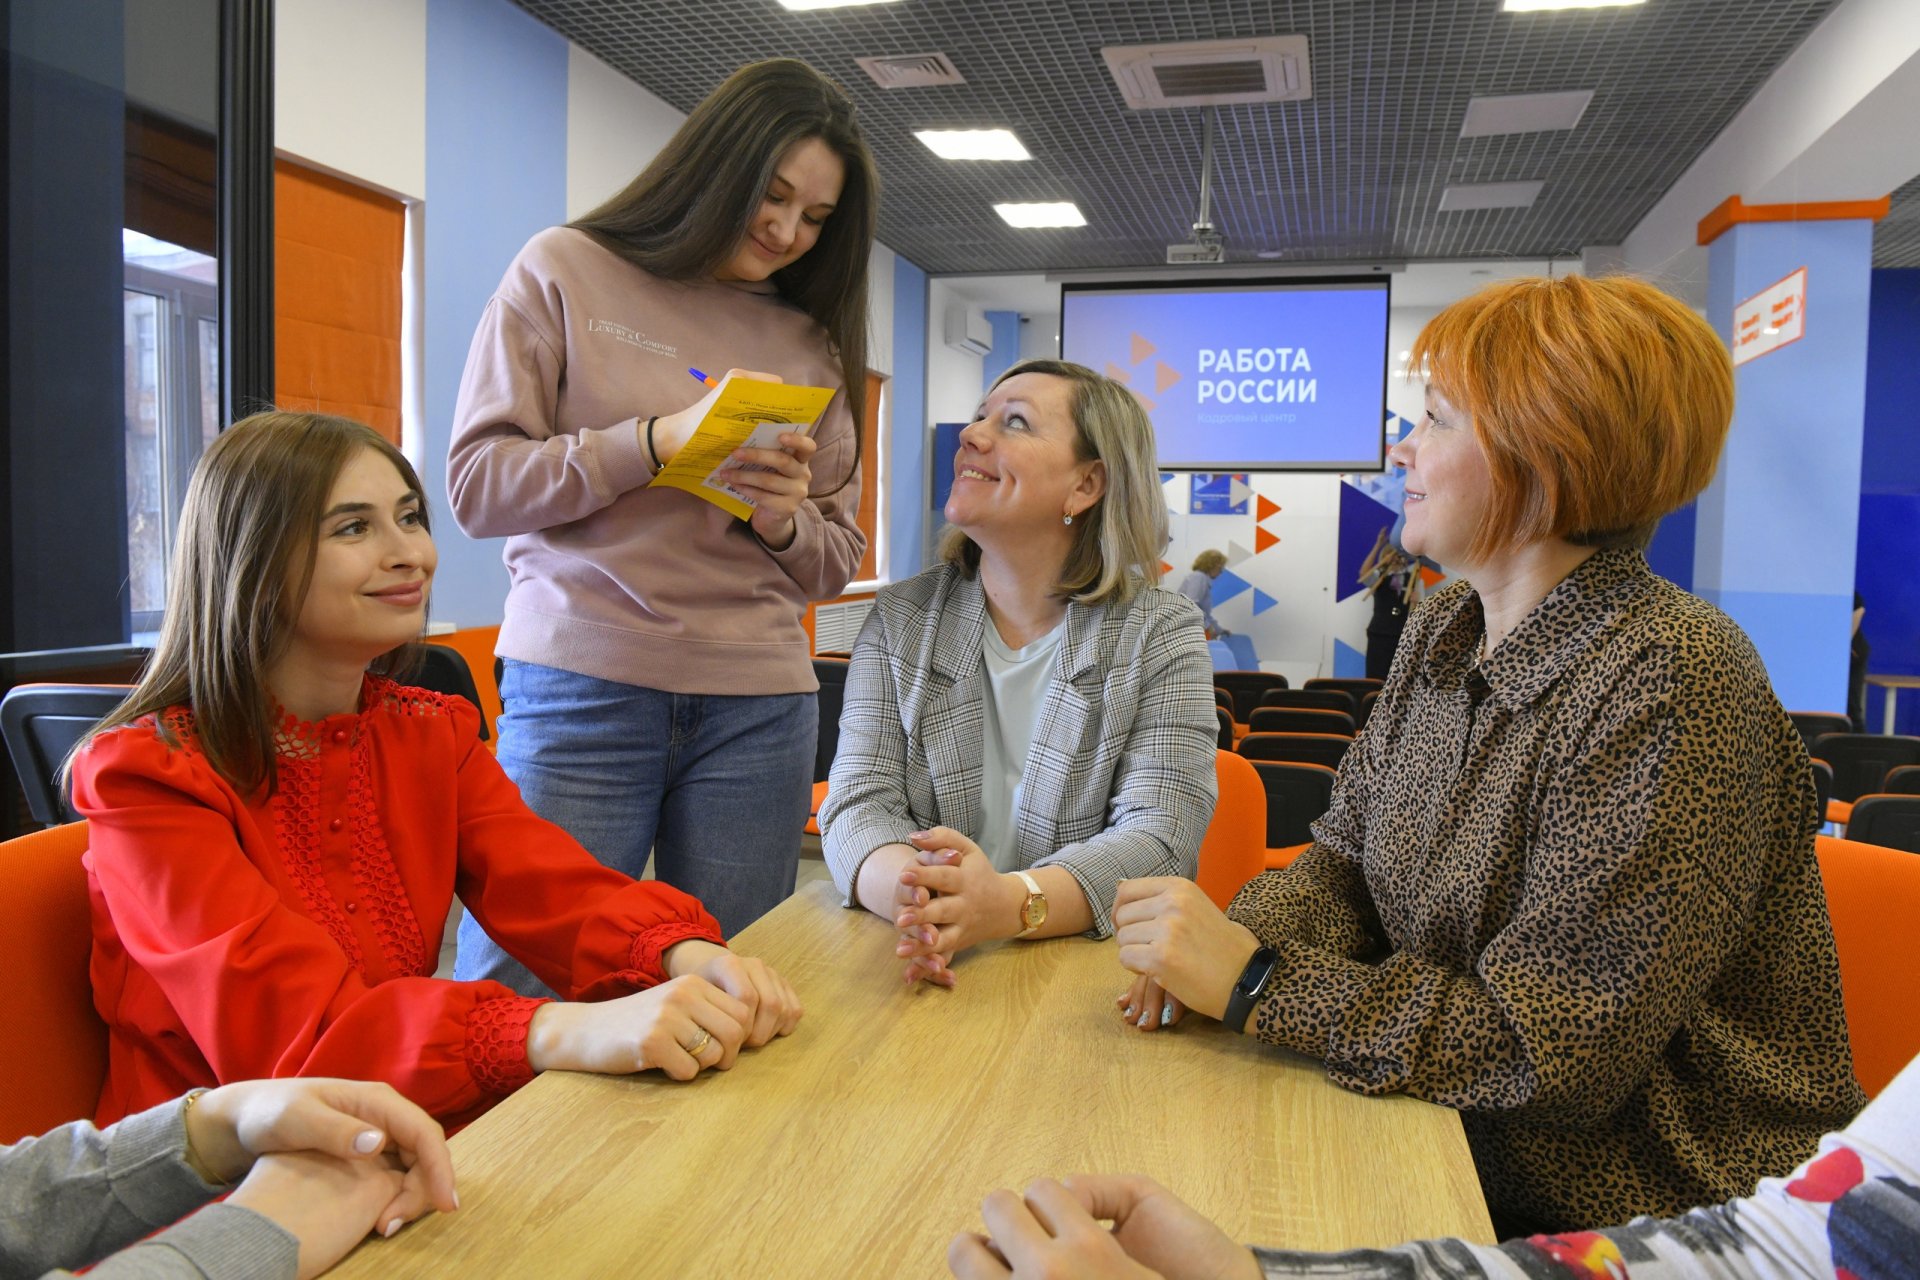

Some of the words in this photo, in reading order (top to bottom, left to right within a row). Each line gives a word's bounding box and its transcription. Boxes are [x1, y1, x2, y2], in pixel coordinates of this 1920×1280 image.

[1198, 347, 1311, 373] РАБОТА
[1198, 378, 1317, 404] РОССИИ
[1198, 412, 1258, 424] Кадровый
[1261, 413, 1297, 424] центр
